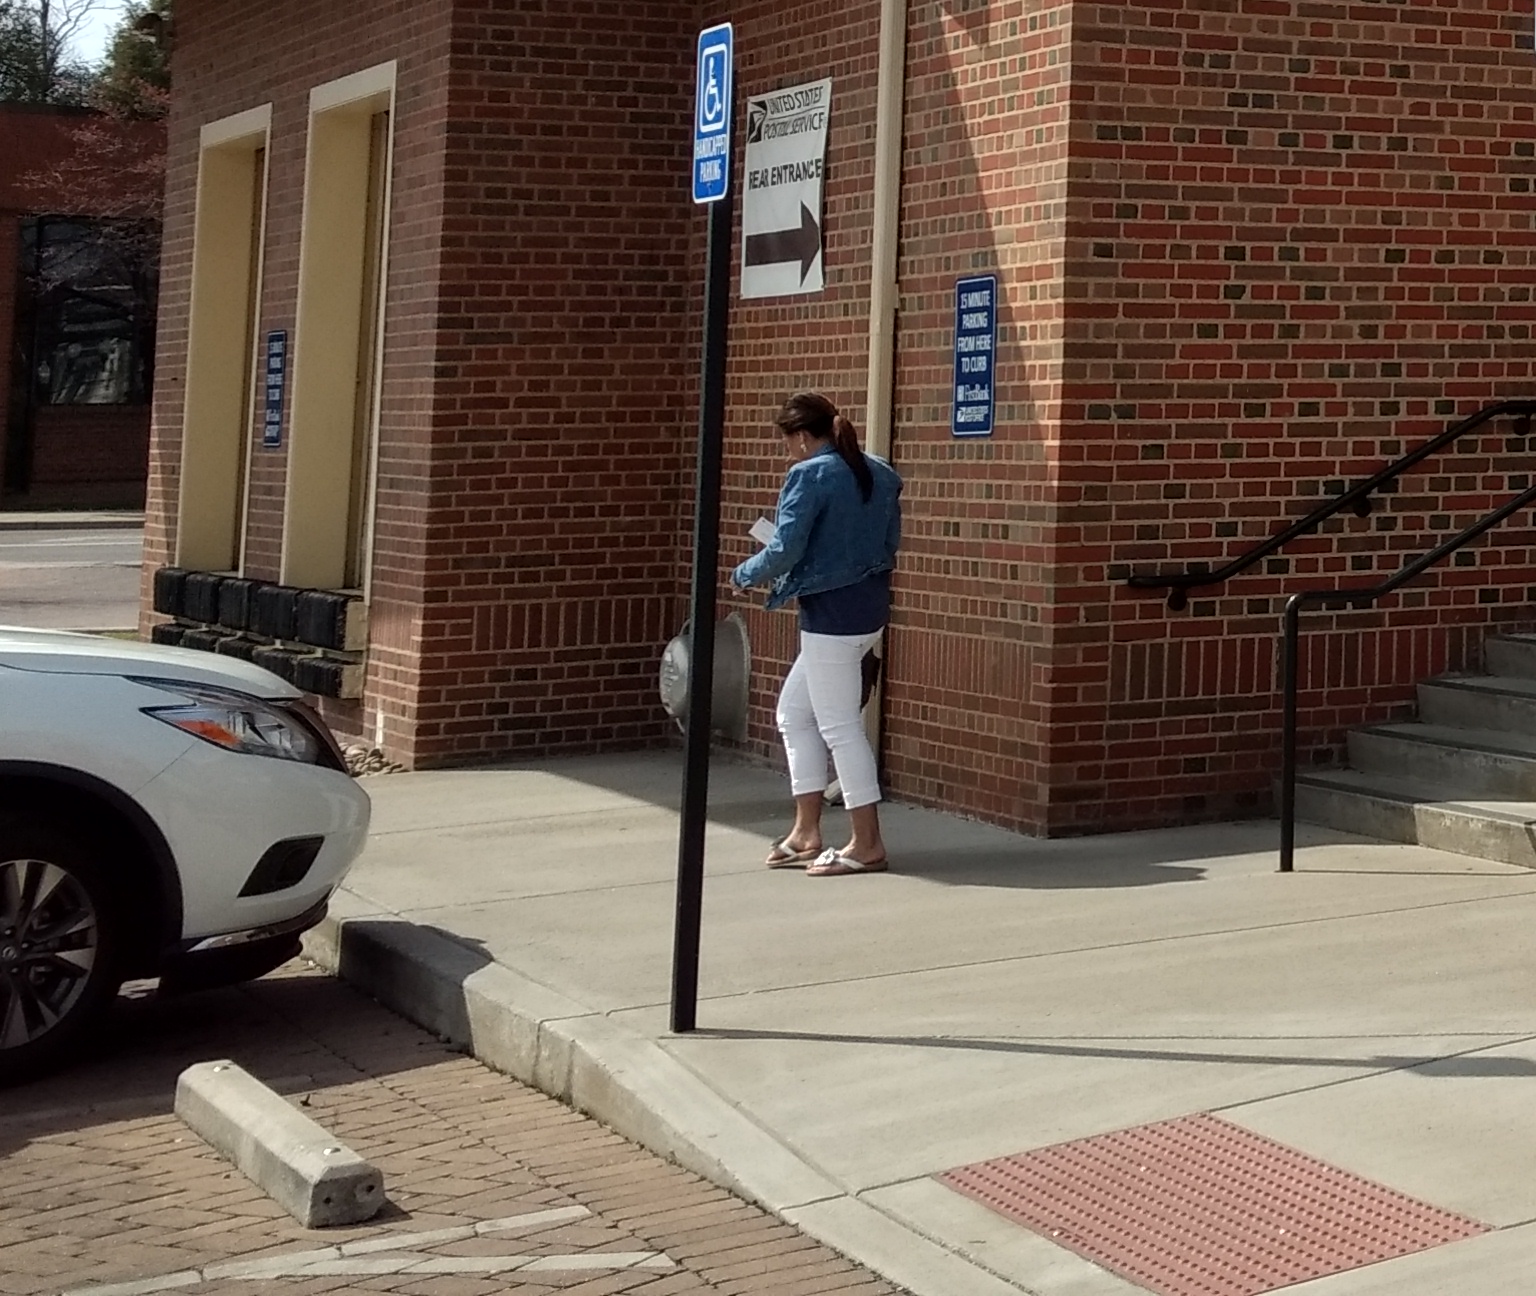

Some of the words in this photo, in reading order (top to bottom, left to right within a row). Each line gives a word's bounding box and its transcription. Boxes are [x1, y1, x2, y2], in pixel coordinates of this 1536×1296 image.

[767, 94, 795, 115] UNITED
[794, 86, 824, 108] STATES
[764, 121, 789, 141] POSTAL
[789, 112, 825, 136] SERVICE
[748, 168, 769, 191] REAR
[771, 158, 822, 185] ENTRANCE
[960, 292, 967, 309] 15
[968, 290, 990, 308] MINUTE
[962, 311, 988, 330] PARKING
[957, 336, 975, 352] FROM
[976, 334, 992, 351] HERE
[961, 356, 969, 373] TO
[970, 355, 987, 373] CURB
